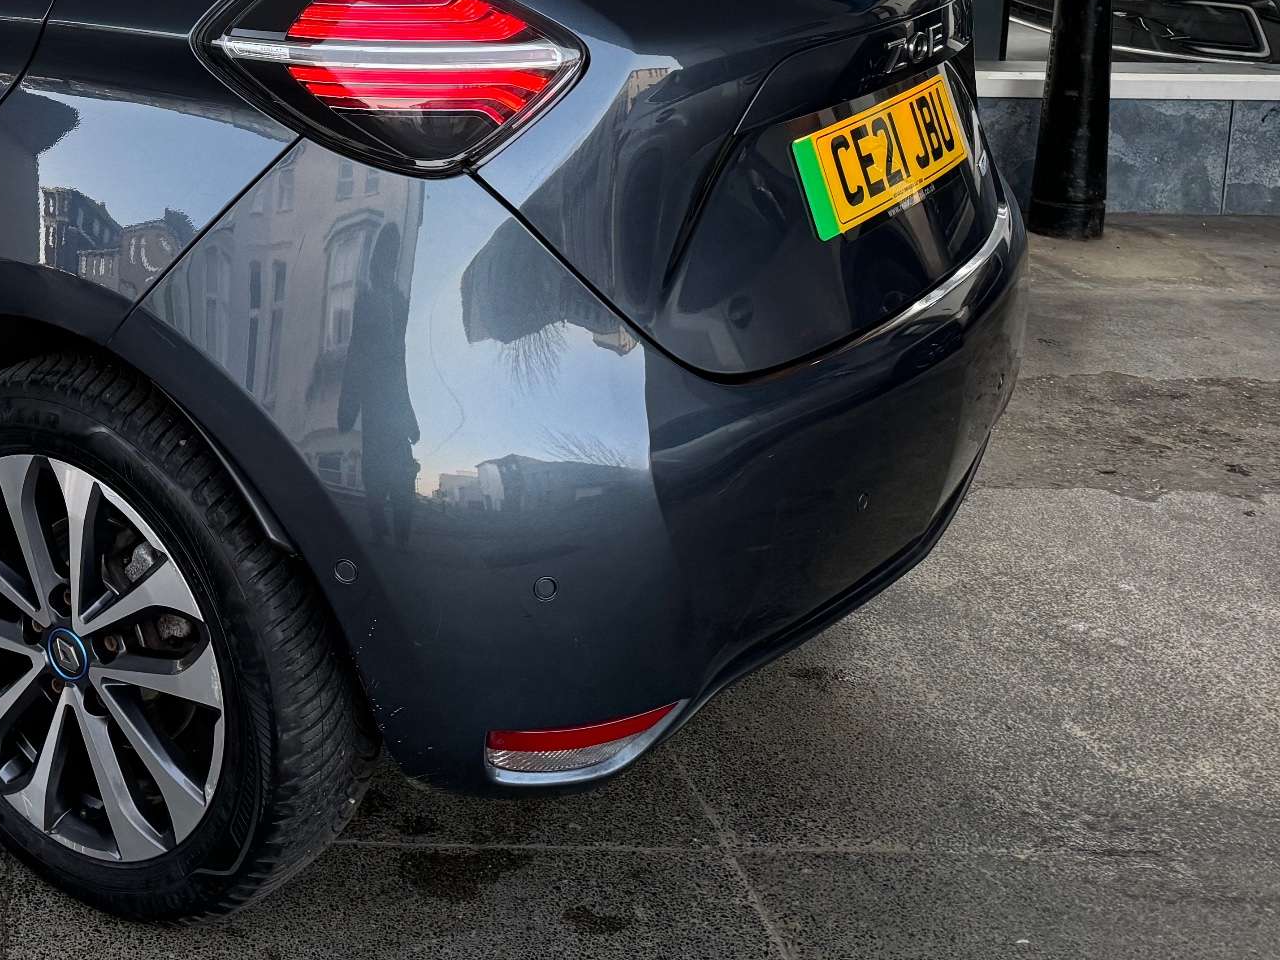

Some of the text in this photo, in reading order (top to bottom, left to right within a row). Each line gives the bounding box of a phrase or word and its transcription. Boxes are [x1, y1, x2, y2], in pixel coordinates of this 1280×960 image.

[883, 22, 944, 74] ZOE
[831, 87, 955, 207] CE21 JBU
